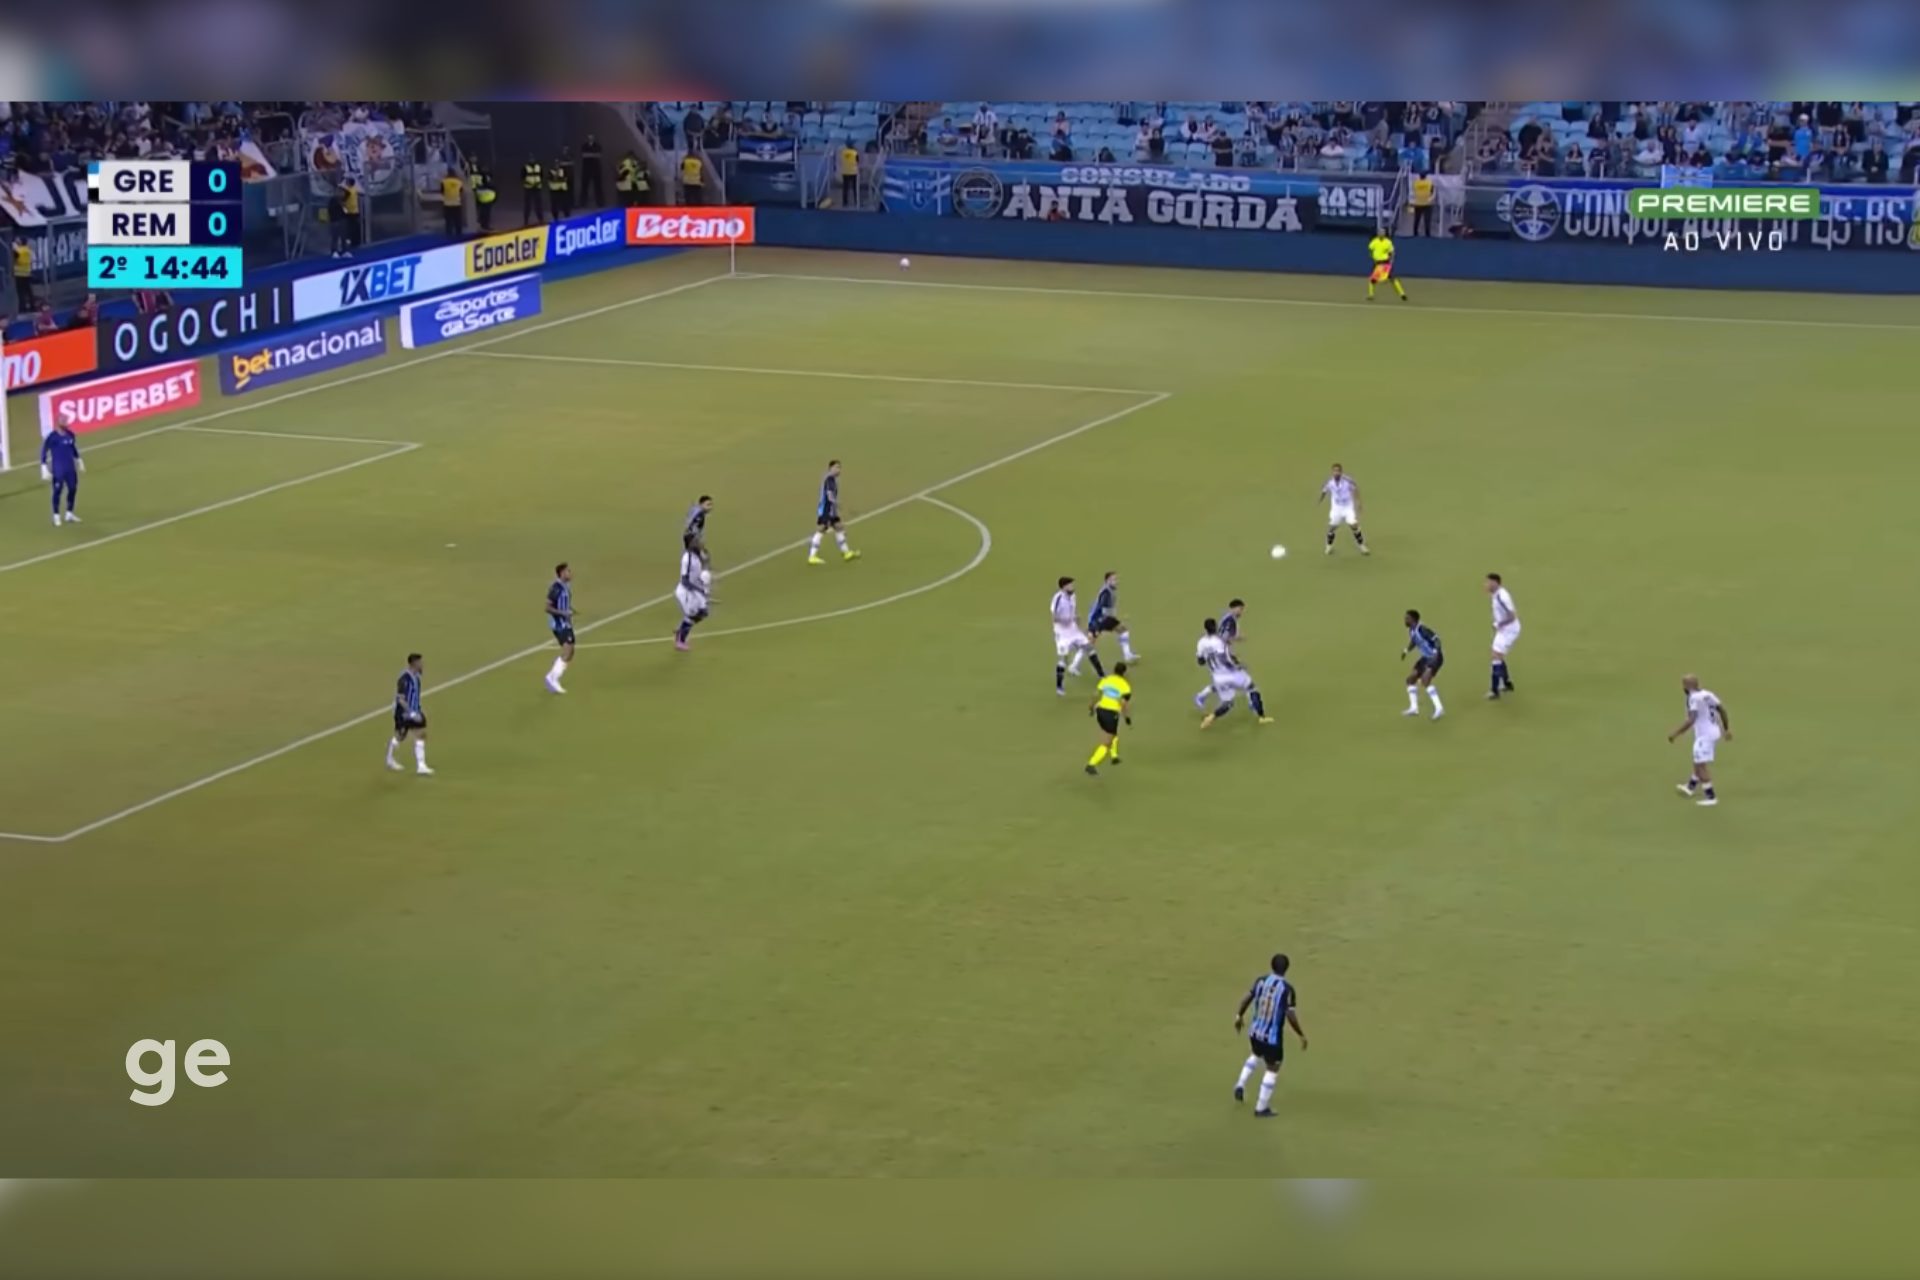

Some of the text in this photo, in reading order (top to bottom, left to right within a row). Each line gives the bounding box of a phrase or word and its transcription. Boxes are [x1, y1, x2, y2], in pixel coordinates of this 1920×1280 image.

[1060, 165, 1250, 191] CONSULADO
[636, 212, 745, 239] Betano
[1003, 183, 1302, 231] ANTA GORDA
[473, 234, 541, 274] Epocler
[556, 216, 621, 257] Epocler
[339, 255, 421, 308] 1XBET
[233, 320, 383, 388] betnacional
[58, 369, 197, 424] SUPERBET
